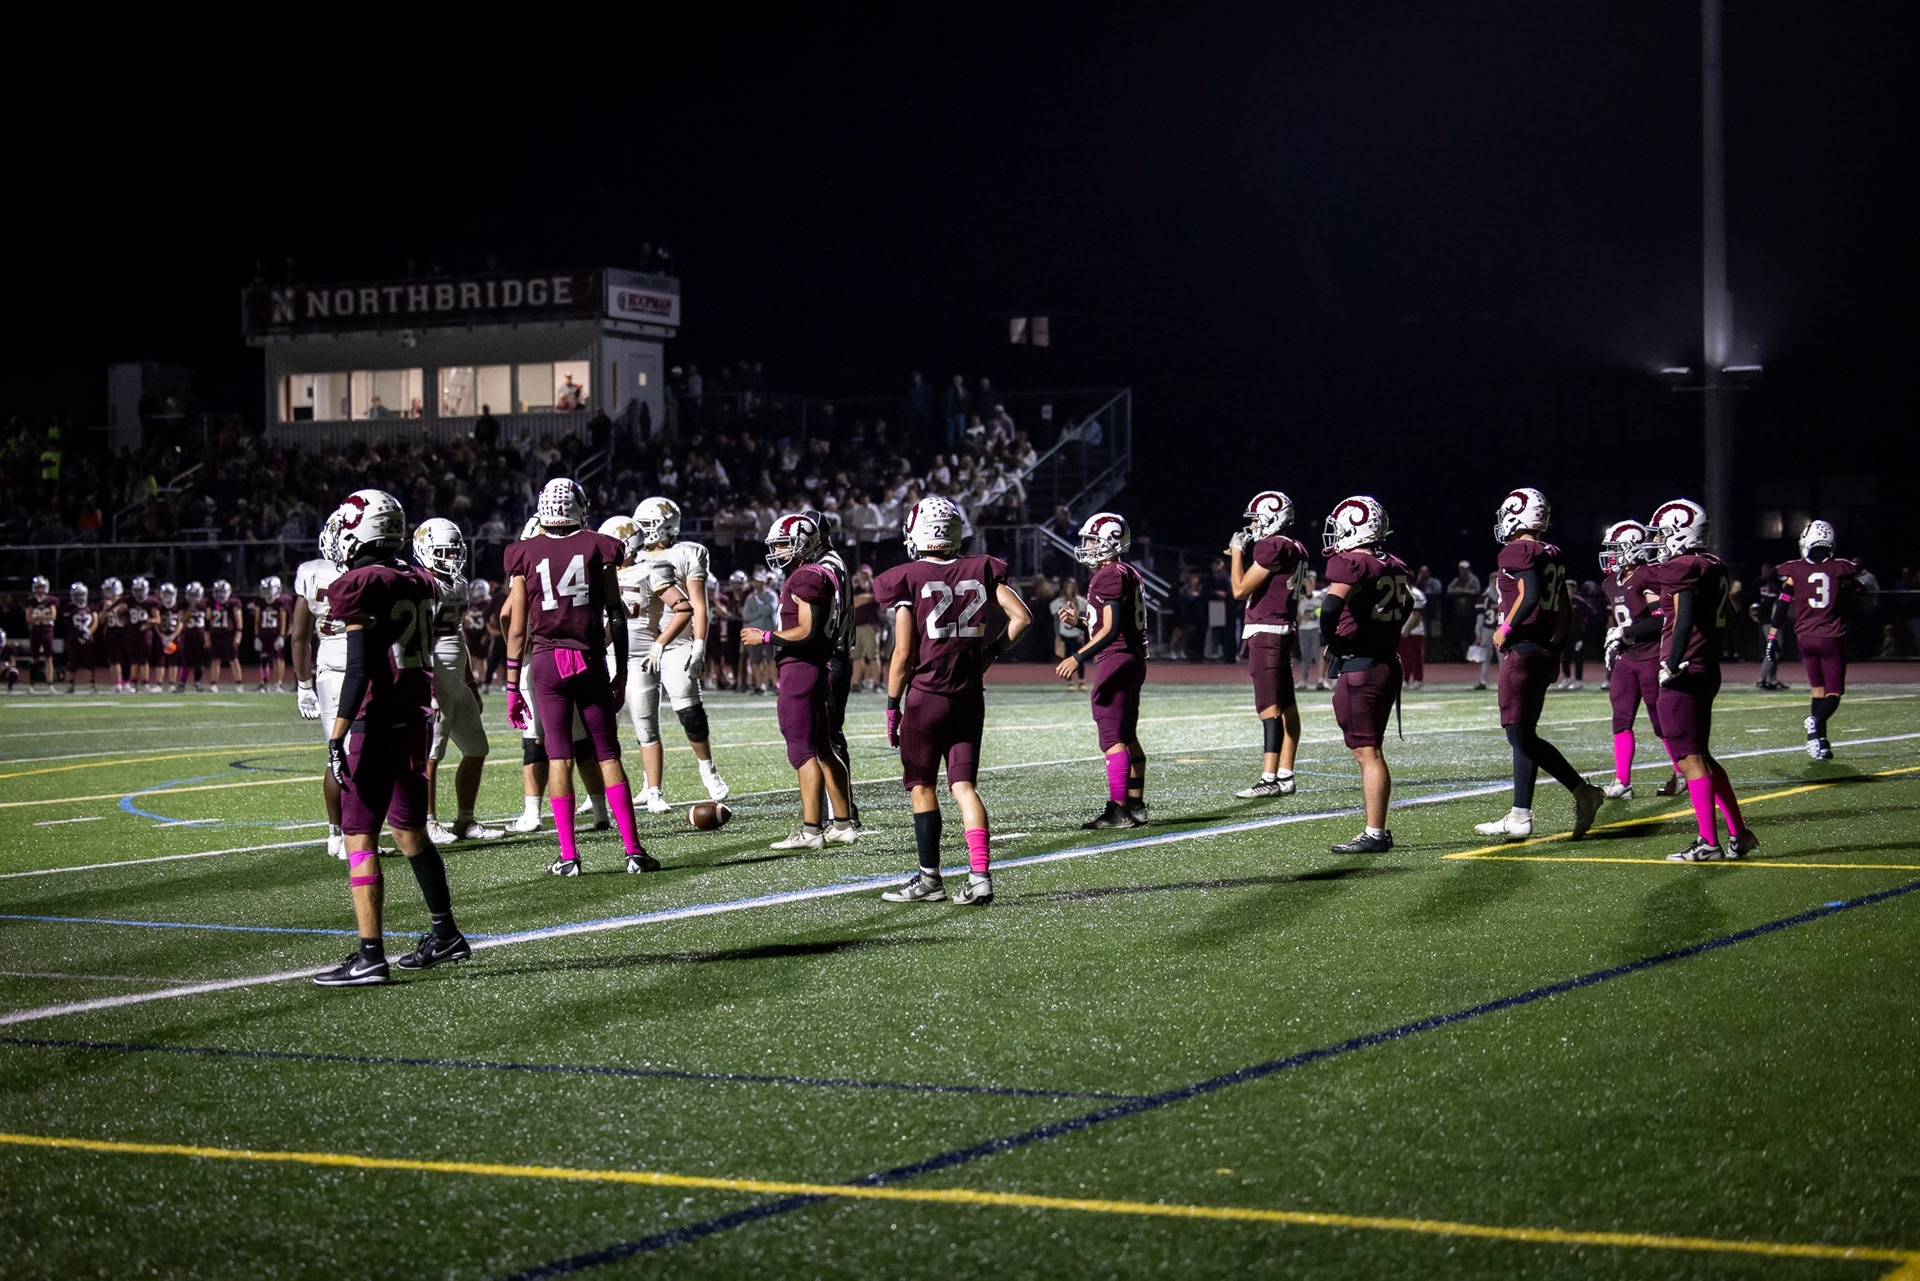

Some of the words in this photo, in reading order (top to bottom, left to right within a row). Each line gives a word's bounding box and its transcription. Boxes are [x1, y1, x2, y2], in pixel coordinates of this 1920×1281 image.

[306, 276, 574, 319] NORTHBRIDGE
[550, 505, 564, 517] 14
[657, 501, 676, 516] M
[616, 522, 637, 539] M
[933, 525, 950, 538] 22
[535, 554, 590, 611] 14
[1807, 572, 1830, 609] 3
[920, 579, 988, 639] 22
[212, 610, 228, 628] 21
[260, 610, 278, 629] 15
